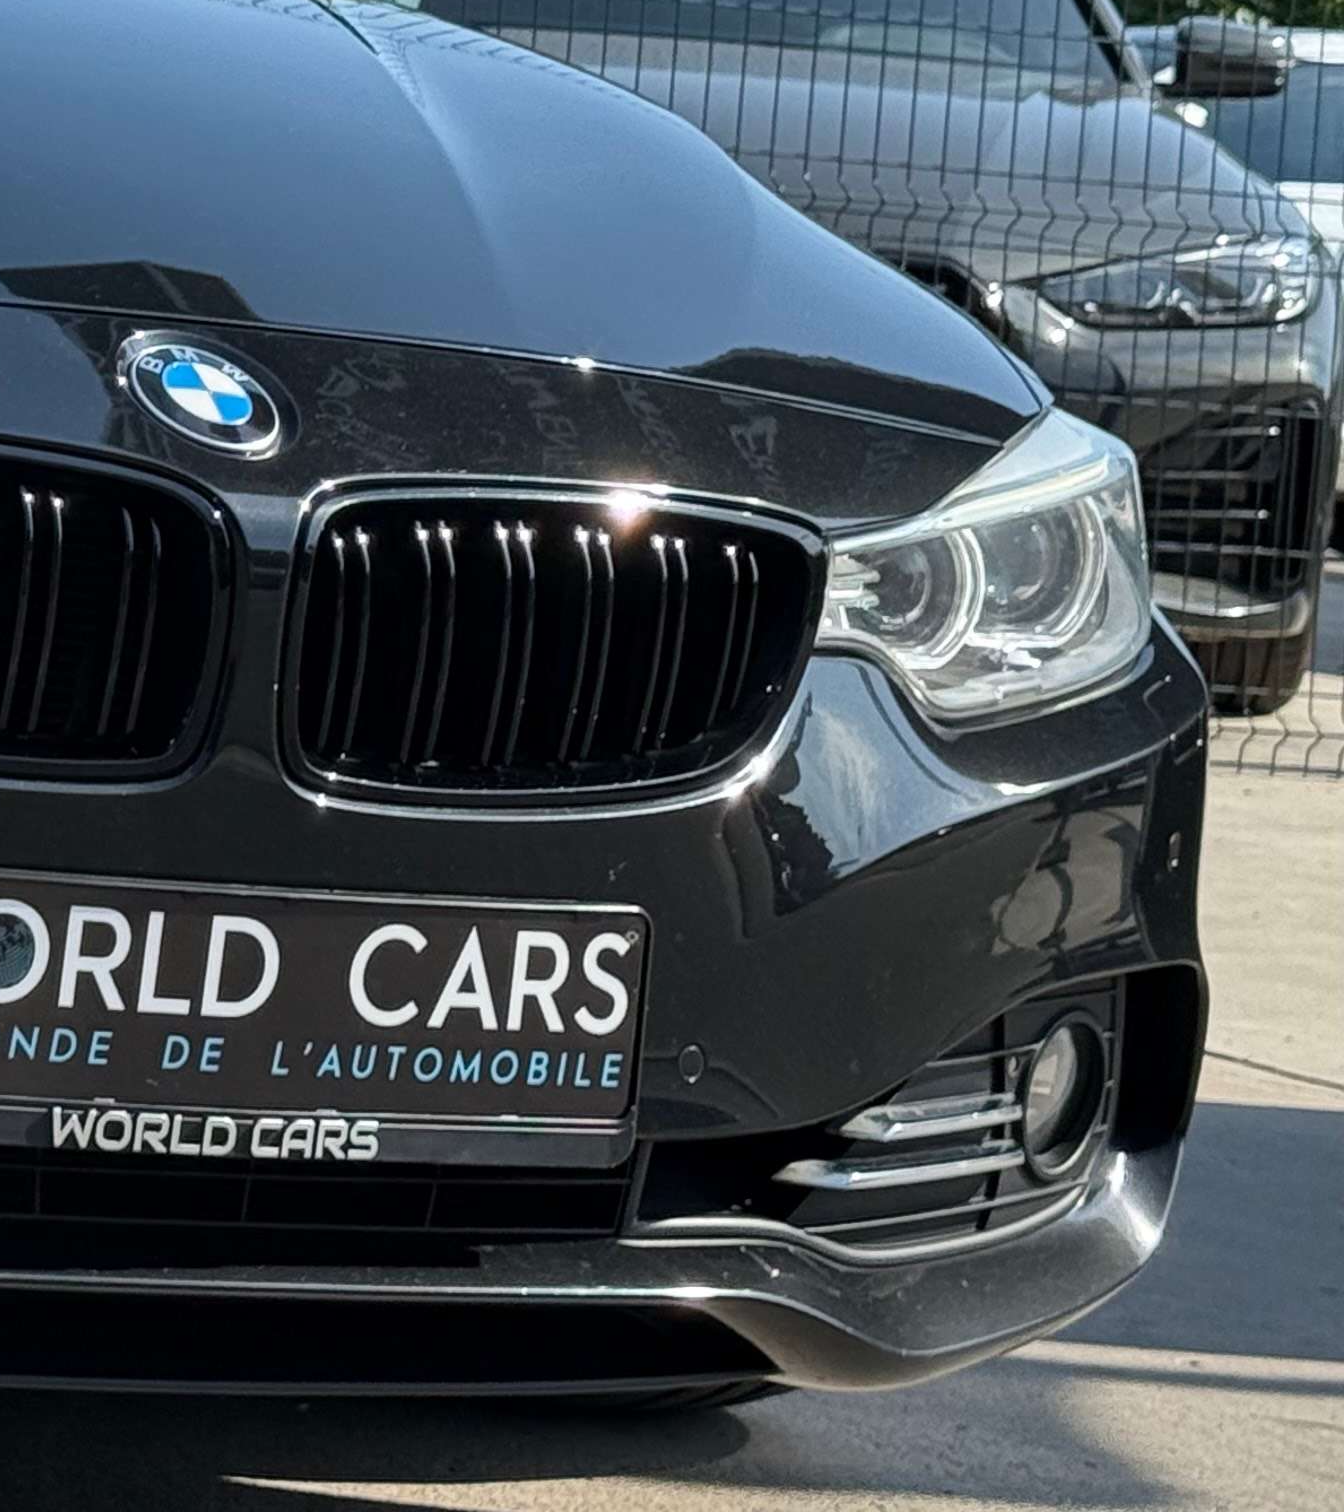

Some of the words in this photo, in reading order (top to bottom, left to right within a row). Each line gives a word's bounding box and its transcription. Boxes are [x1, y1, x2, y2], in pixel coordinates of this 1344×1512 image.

[138, 346, 250, 383] BMW
[348, 922, 632, 1036] CARS
[160, 1034, 225, 1072] DE
[269, 1040, 624, 1089] L'AUTOMOBILE
[52, 1105, 238, 1157] WORLD
[250, 1117, 380, 1161] CARS
